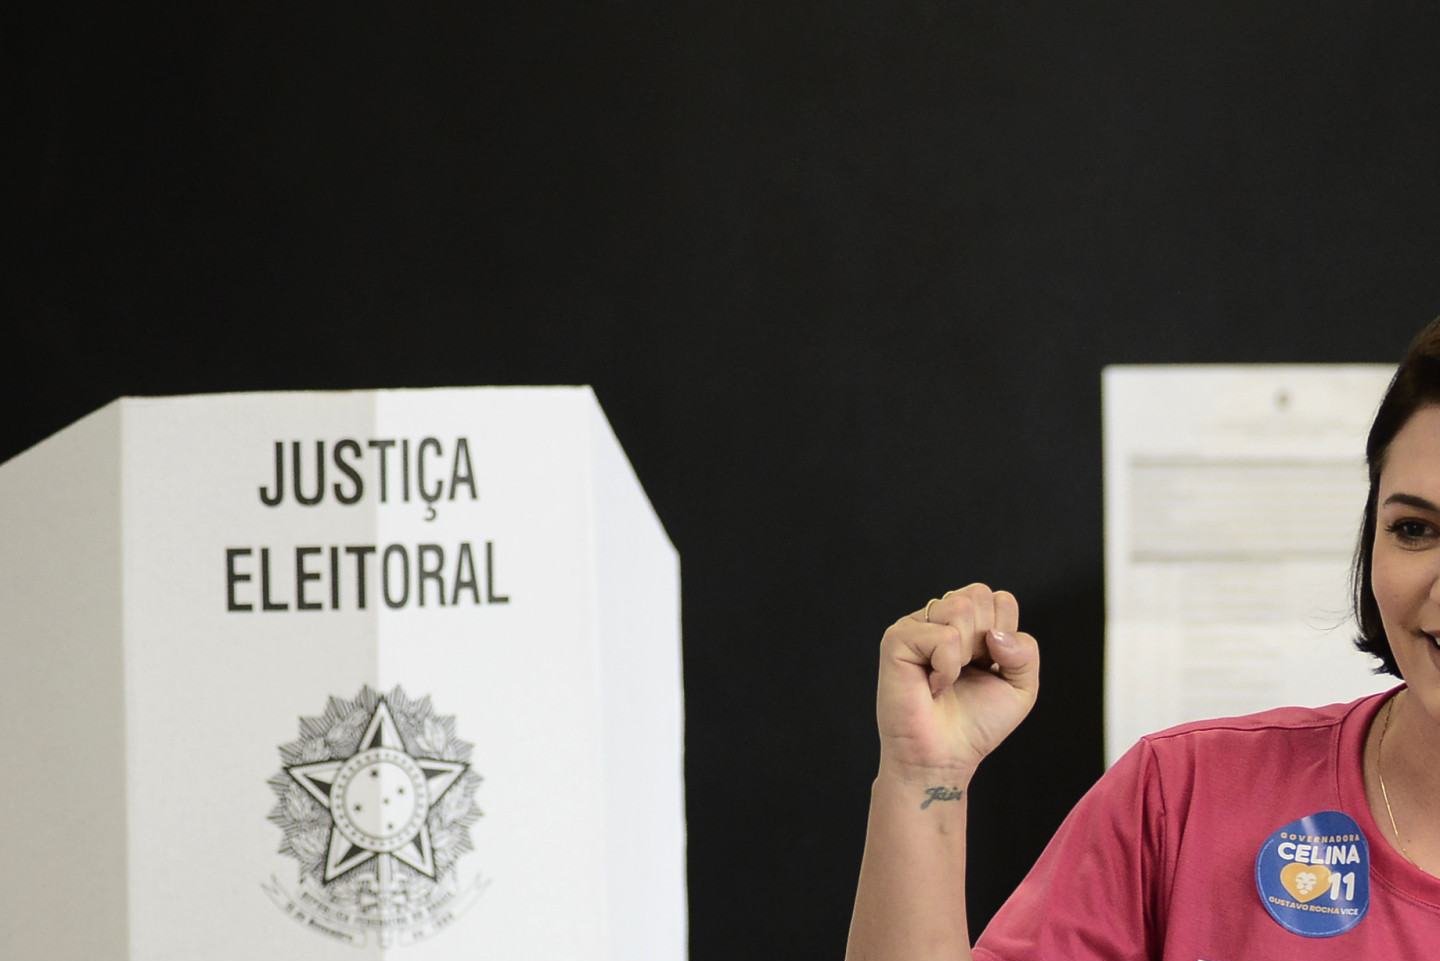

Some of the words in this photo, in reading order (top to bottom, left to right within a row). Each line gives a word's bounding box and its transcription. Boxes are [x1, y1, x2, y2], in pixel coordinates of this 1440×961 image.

[259, 437, 479, 521] JUSTIÇA
[225, 541, 510, 612] ELEITORAL
[1280, 832, 1360, 842] GOVERNADORA
[1277, 842, 1360, 864] CELINA
[1328, 871, 1355, 901] 11
[1268, 895, 1308, 911] GUSTAVO
[1309, 904, 1341, 915] ROCHA
